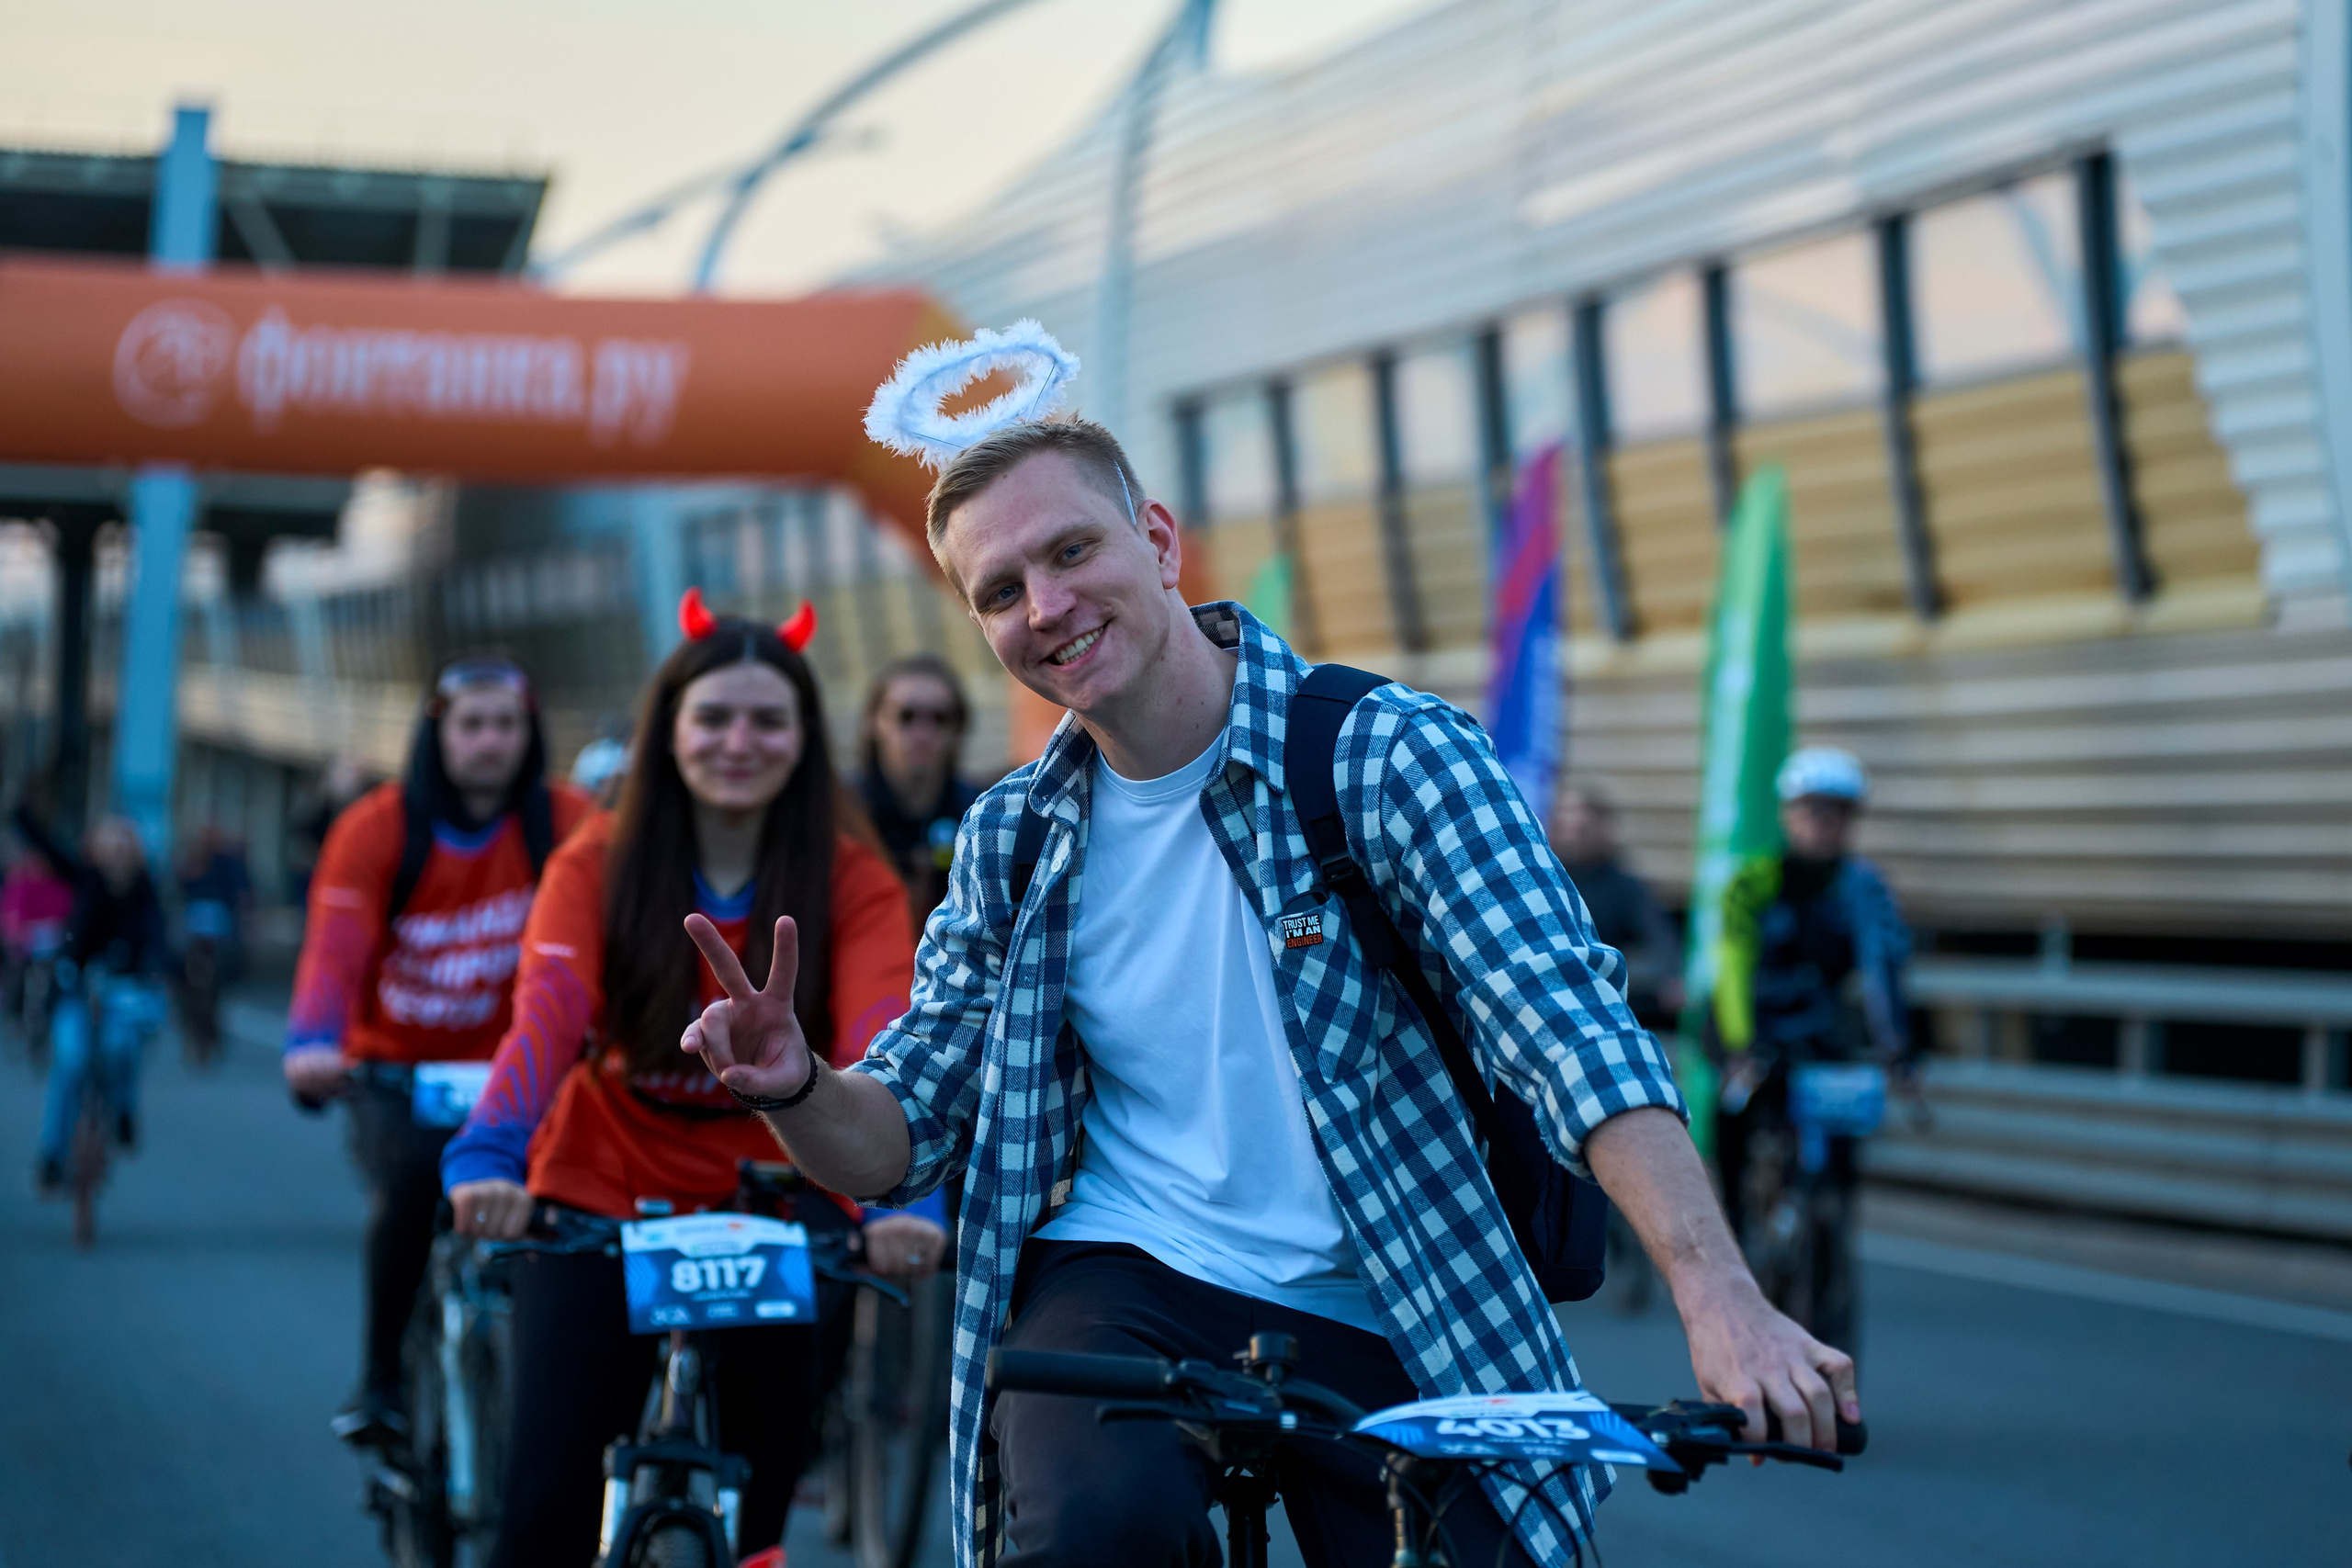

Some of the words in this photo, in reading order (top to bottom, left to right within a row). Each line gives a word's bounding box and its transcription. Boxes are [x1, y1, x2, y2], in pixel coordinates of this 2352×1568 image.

[1283, 918, 1306, 930] TRUST
[1307, 915, 1319, 926] ME
[1285, 929, 1303, 938] I'M
[1306, 925, 1321, 935] AN
[1287, 934, 1323, 948] ENGINEER
[672, 1256, 766, 1292] 8117
[1436, 1418, 1591, 1440] 4013
